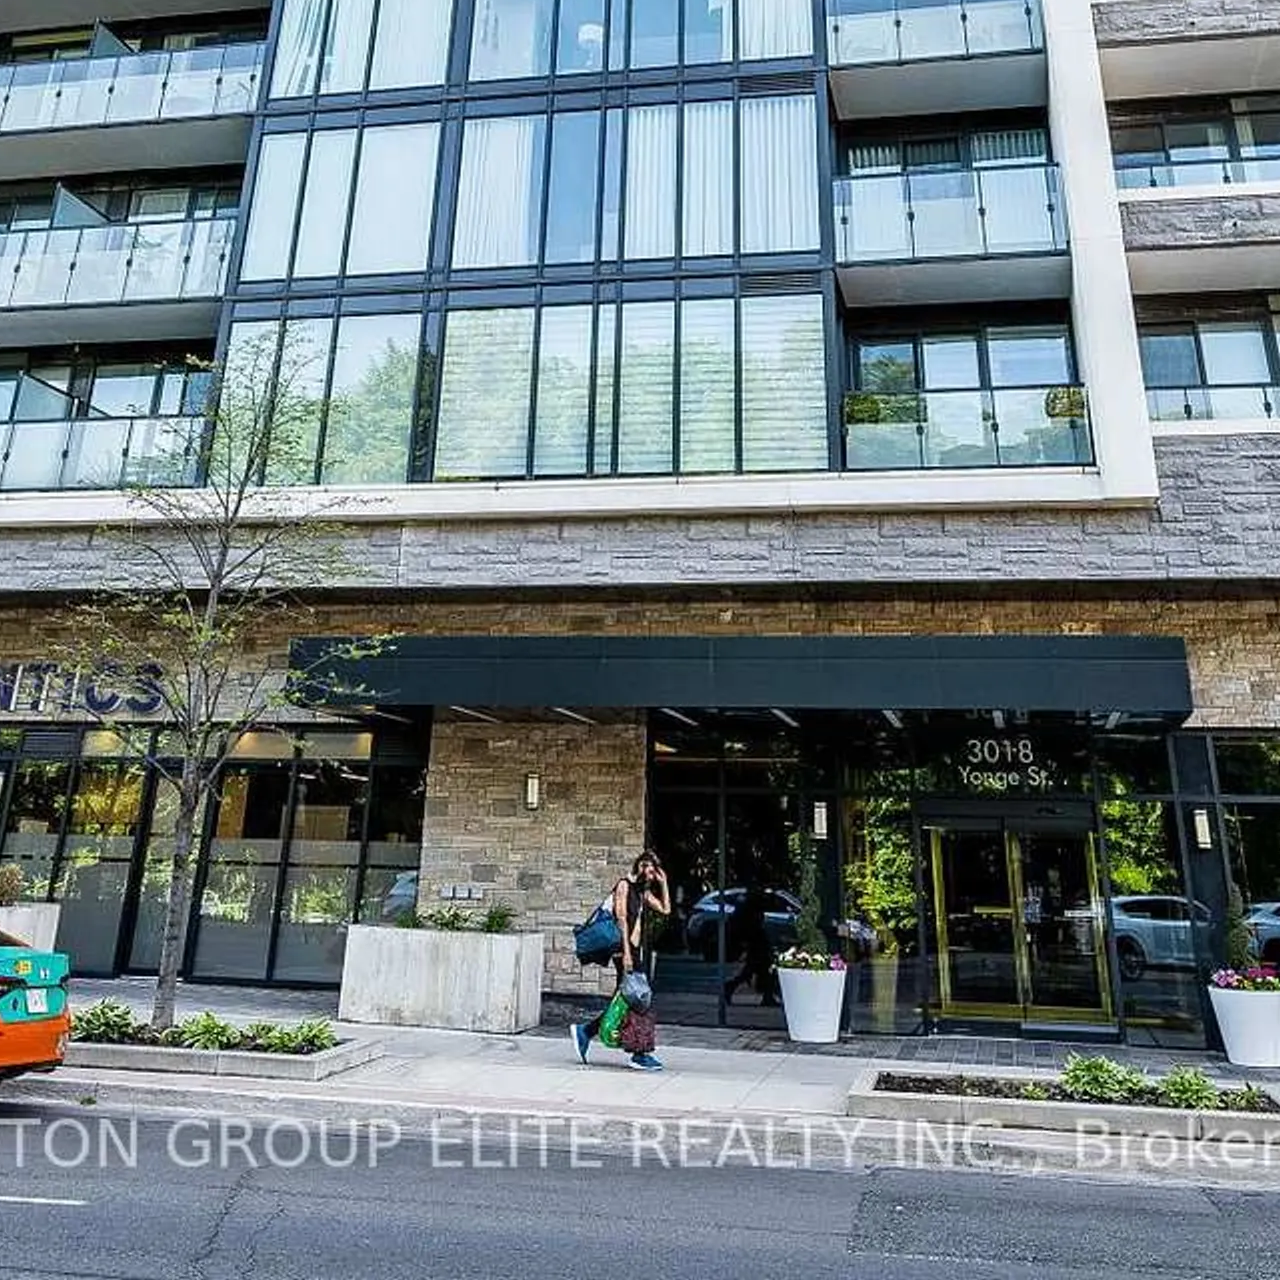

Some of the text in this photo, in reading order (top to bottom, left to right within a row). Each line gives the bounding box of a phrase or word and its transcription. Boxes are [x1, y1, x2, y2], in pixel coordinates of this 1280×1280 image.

[967, 739, 1034, 763] 3018
[958, 765, 1054, 790] Yonge St.
